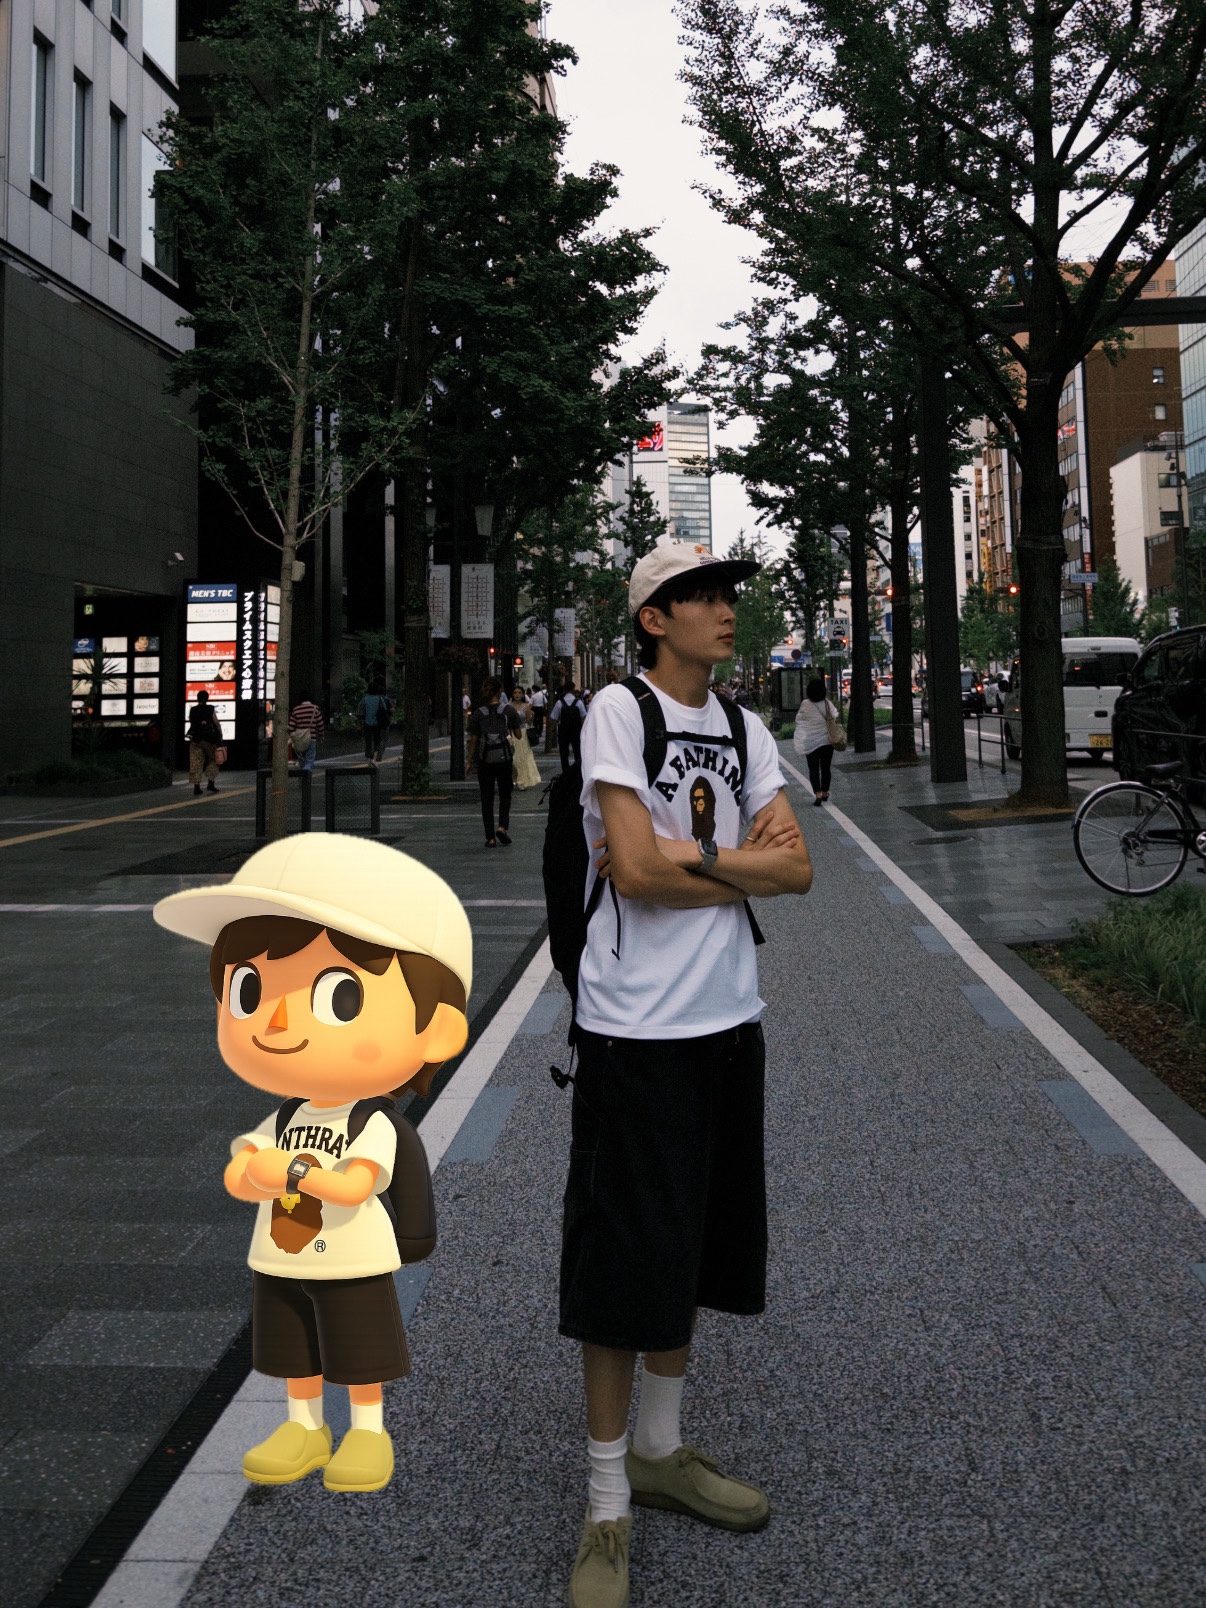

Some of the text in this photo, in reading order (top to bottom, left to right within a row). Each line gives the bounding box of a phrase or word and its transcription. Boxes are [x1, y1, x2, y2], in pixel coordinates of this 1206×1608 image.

[191, 589, 234, 598] MEN'S TBC
[655, 781, 679, 803] A
